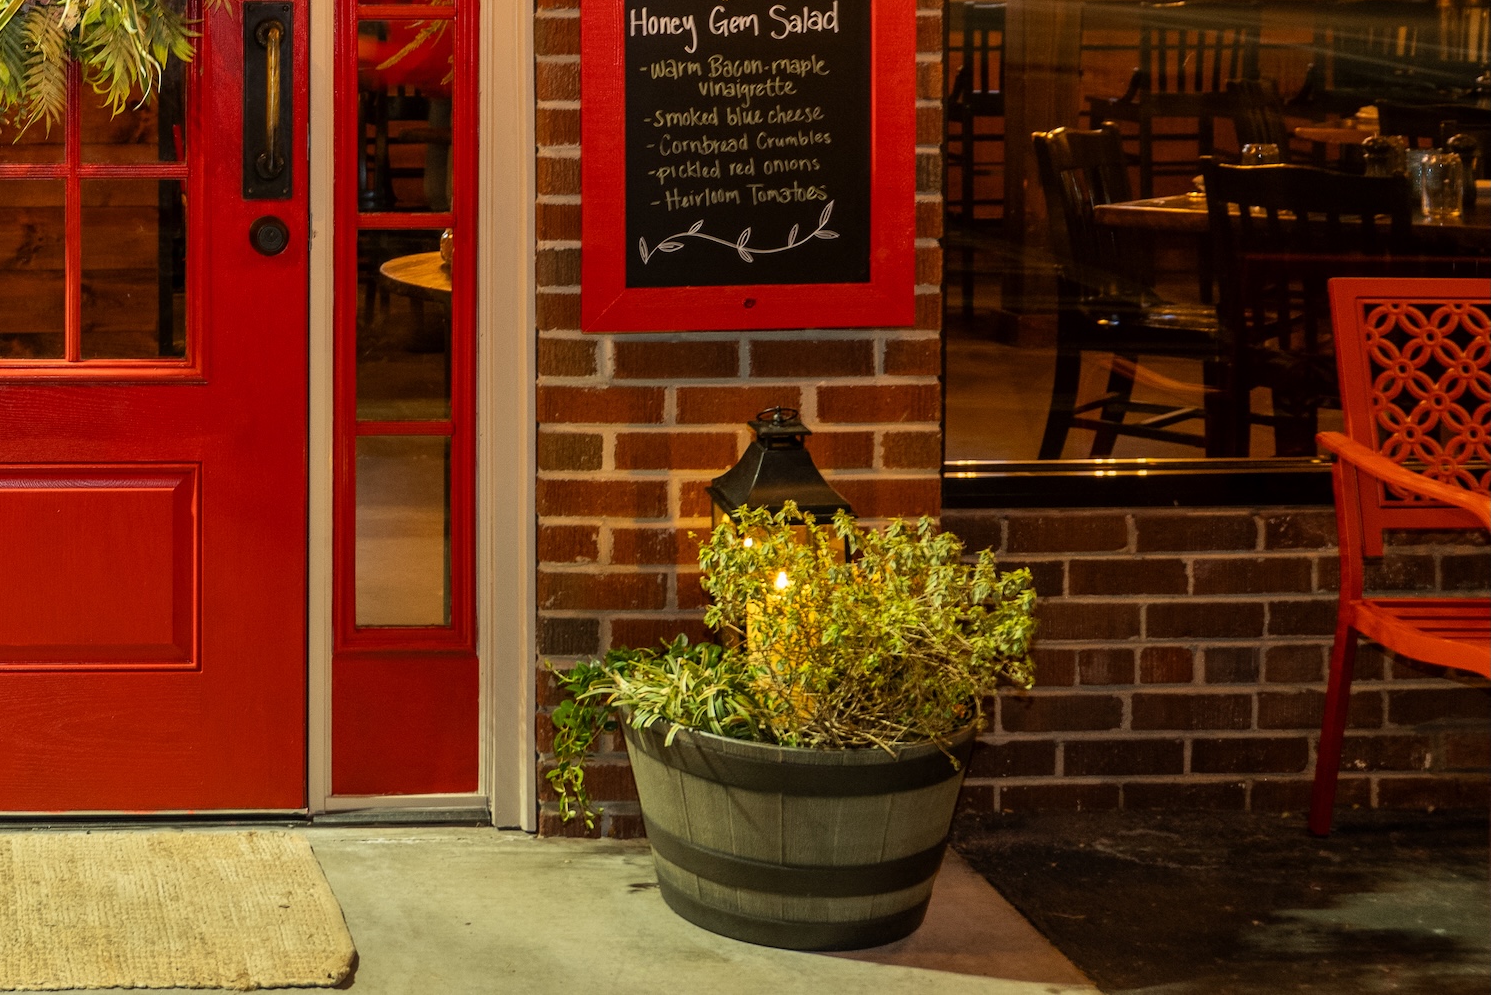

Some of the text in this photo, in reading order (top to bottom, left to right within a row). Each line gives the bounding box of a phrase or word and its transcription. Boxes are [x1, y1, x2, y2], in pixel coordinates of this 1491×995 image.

[630, 0, 839, 54] Honey Gem Salad
[698, 77, 797, 108] vinaigrette
[727, 105, 763, 126] blue
[768, 105, 825, 124] cheese
[757, 130, 832, 149] Crumbles
[729, 158, 755, 177] red
[763, 158, 821, 175] onions
[746, 181, 828, 205] Tomatoes
